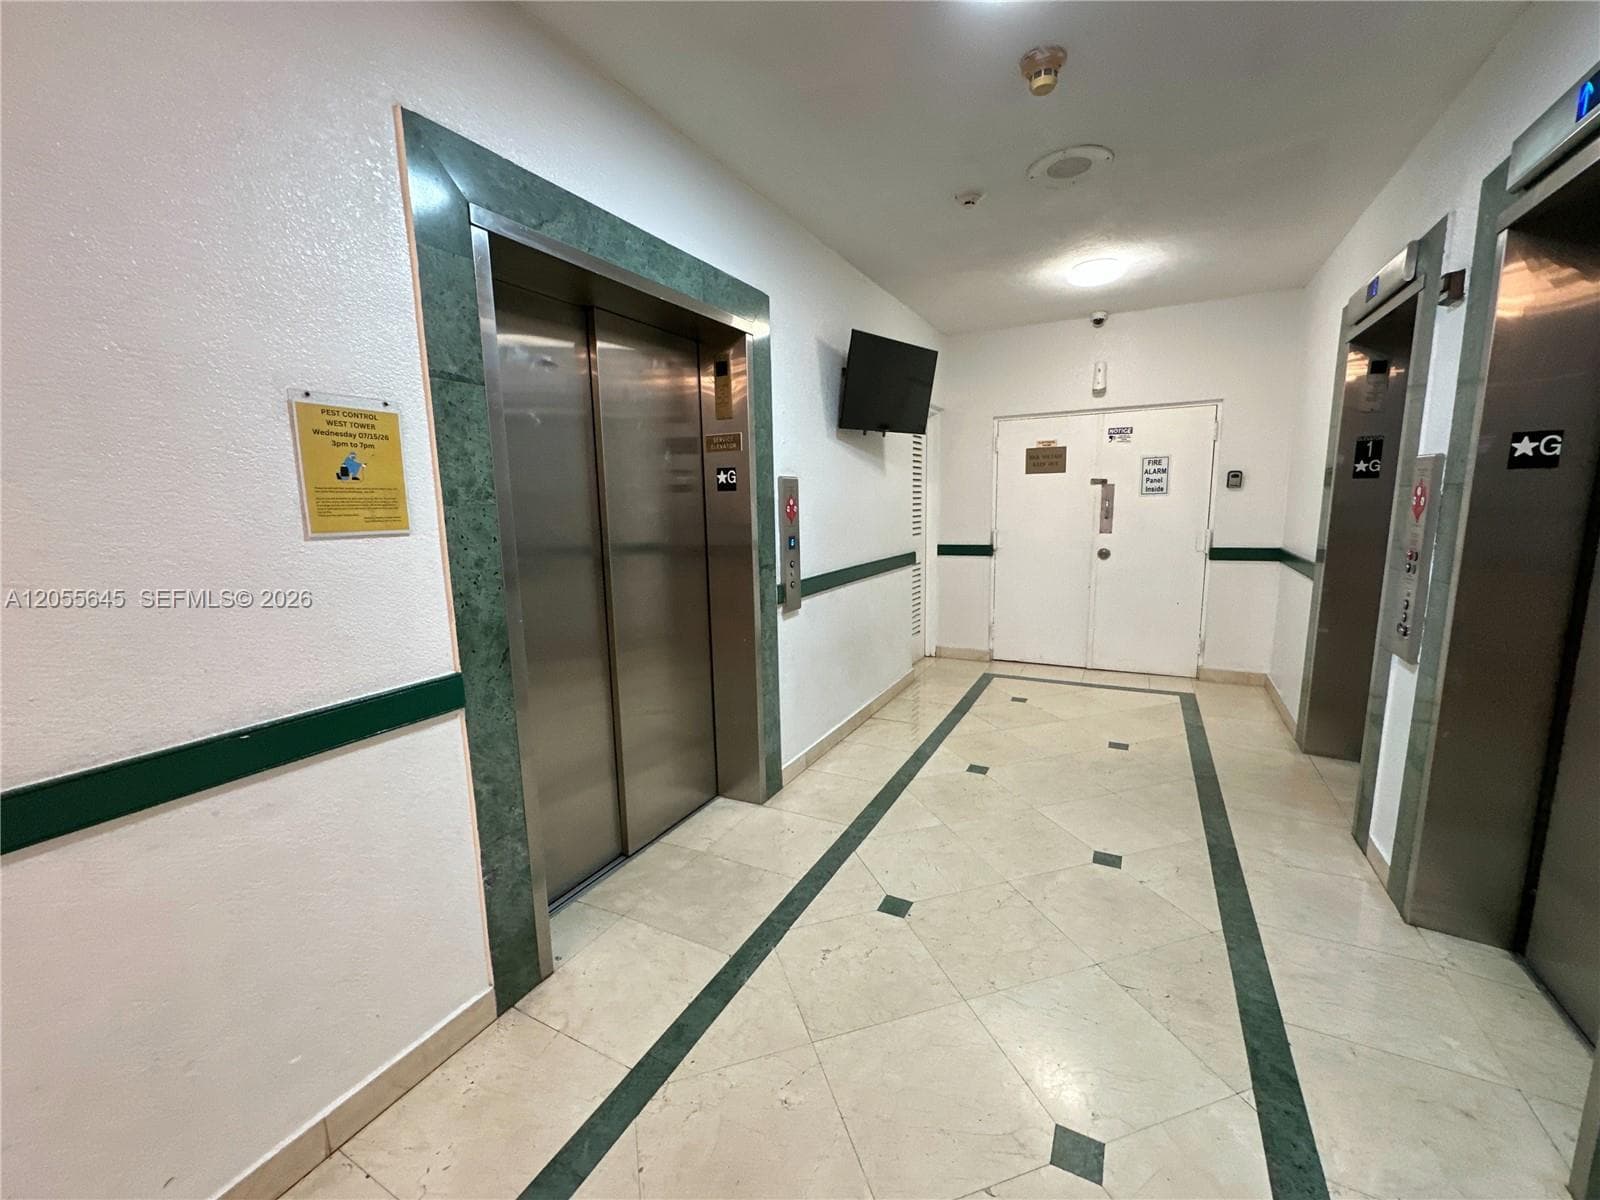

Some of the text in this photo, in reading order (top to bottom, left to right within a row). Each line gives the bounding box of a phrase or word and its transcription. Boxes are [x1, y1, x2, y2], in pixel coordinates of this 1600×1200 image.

[342, 411, 379, 421] CONTROL
[326, 419, 376, 430] WEST TOWER
[312, 429, 357, 439] Wednesday
[331, 440, 349, 448] 3pm
[359, 442, 375, 450] 7pm
[1366, 441, 1373, 457] 1
[1369, 459, 1381, 472] G
[727, 470, 736, 483] G
